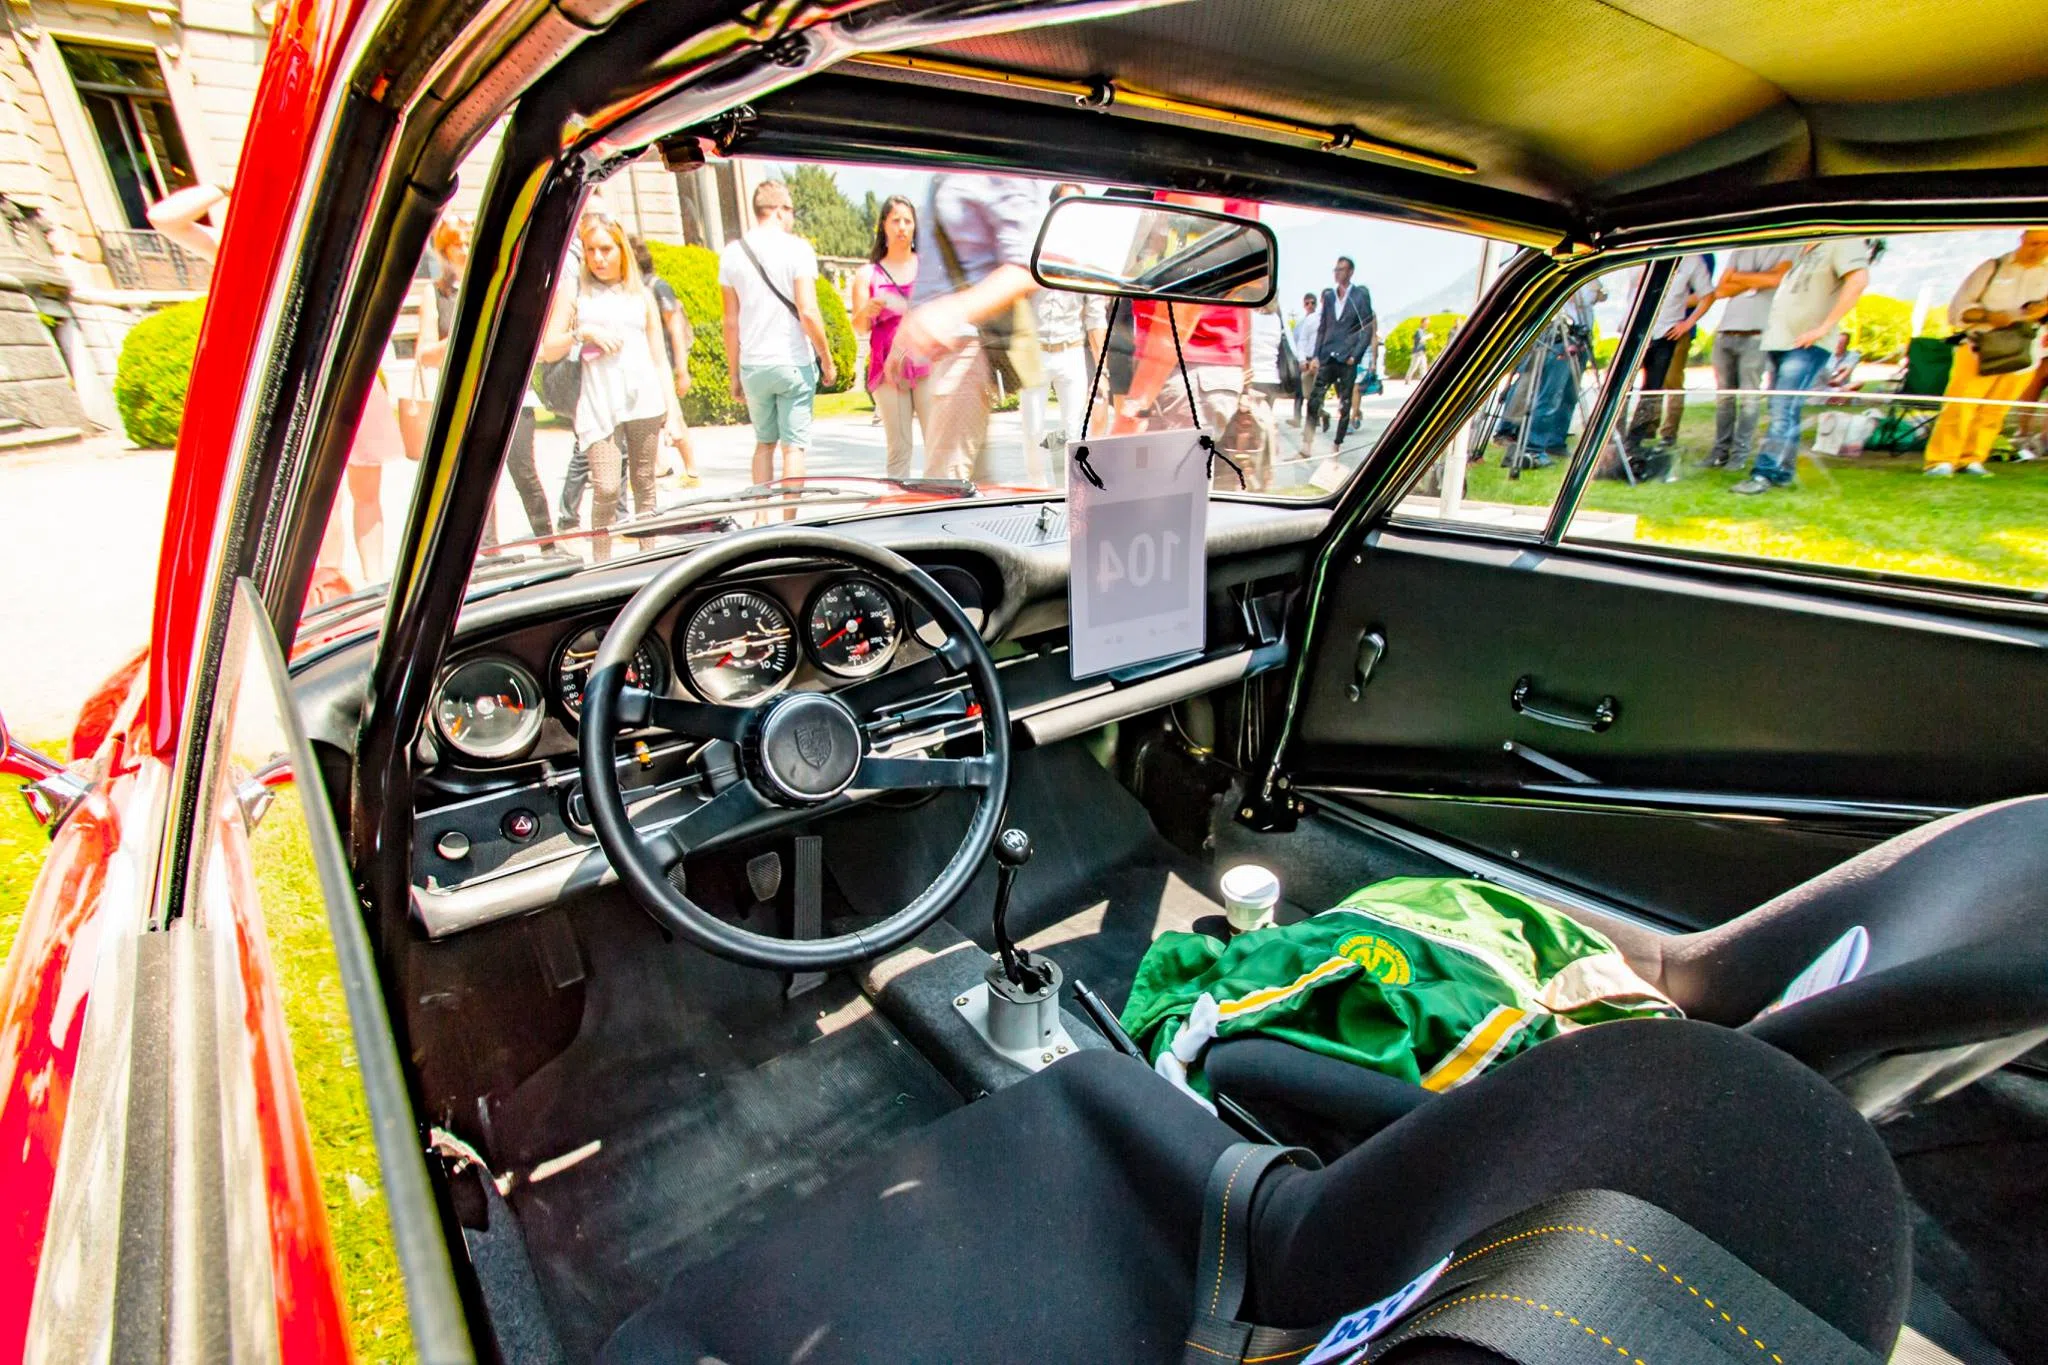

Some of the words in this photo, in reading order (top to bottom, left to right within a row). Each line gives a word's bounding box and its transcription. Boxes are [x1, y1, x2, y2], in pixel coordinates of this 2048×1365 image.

[723, 608, 731, 617] 5
[741, 610, 749, 618] 6
[707, 617, 715, 625] 4
[698, 631, 706, 640] 3
[768, 644, 775, 653] 9
[760, 660, 771, 669] 10
[562, 673, 574, 681] 120
[563, 684, 576, 692] 100
